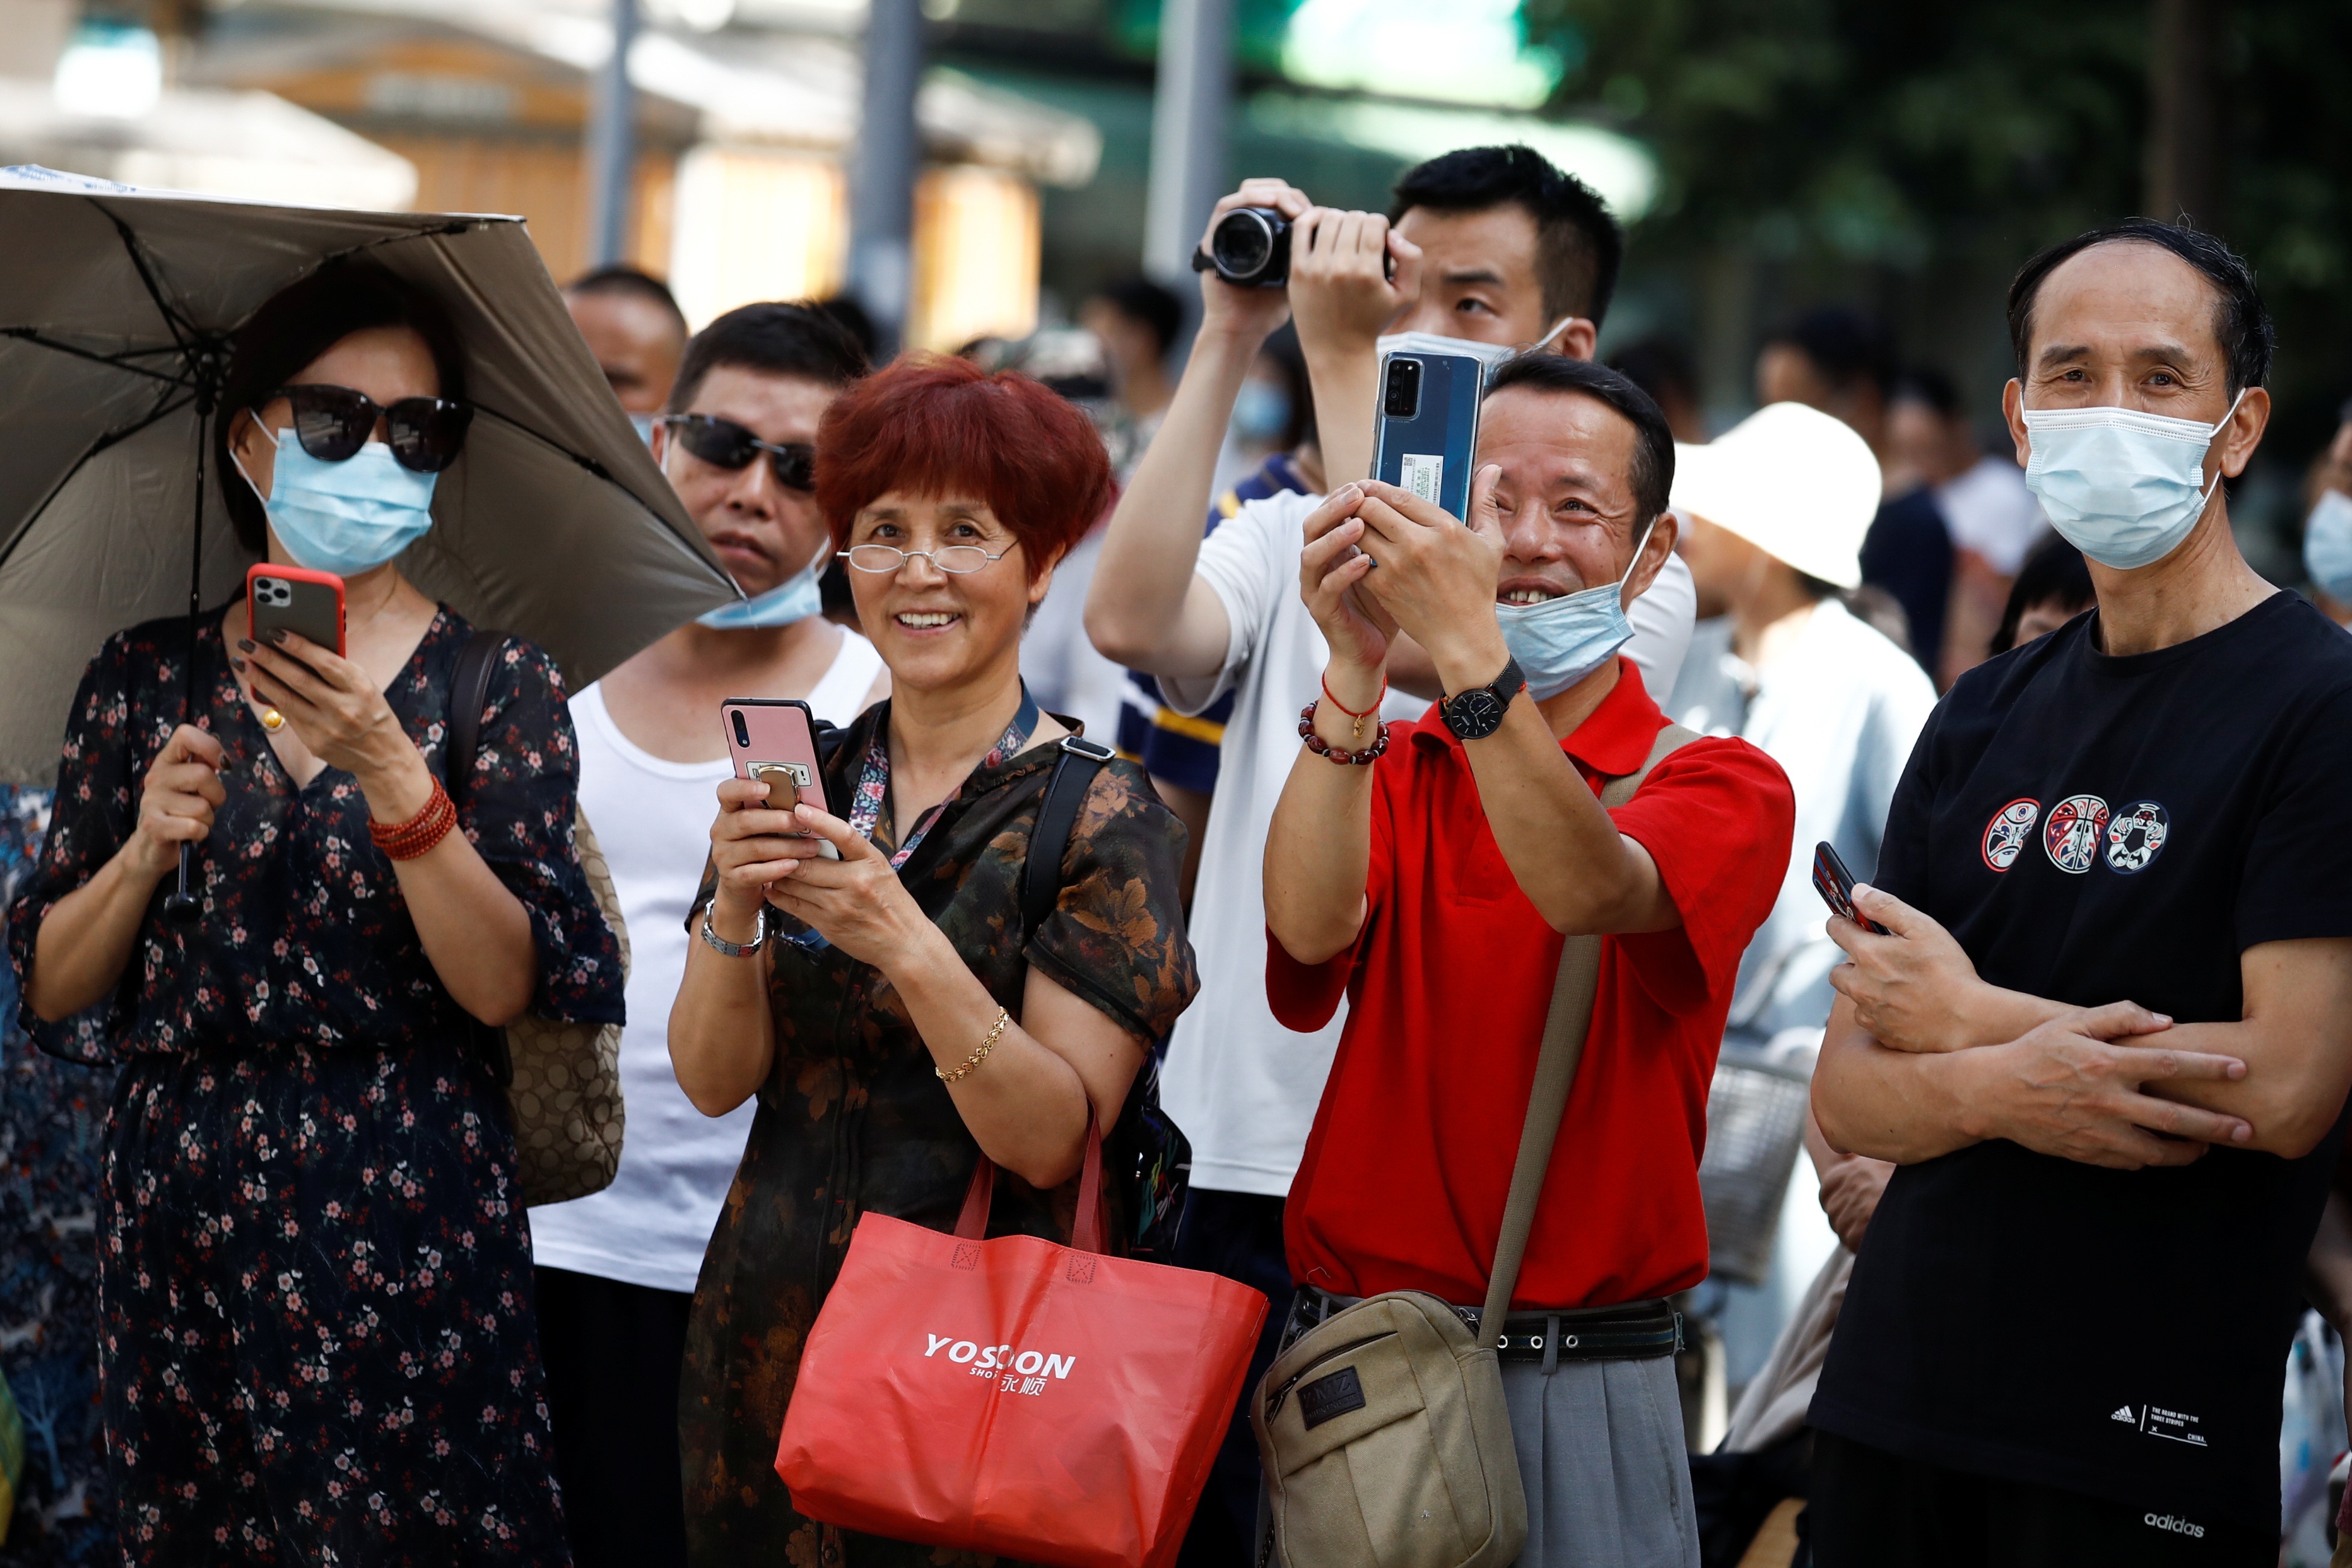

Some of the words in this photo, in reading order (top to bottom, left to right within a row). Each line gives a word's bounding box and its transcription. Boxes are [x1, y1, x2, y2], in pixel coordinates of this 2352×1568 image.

[999, 1373, 1048, 1396] 永顺
[2111, 1413, 2136, 1424] adidas
[2151, 1413, 2165, 1423] THREE
[2165, 1417, 2184, 1427] STRIPES
[2152, 1406, 2161, 1414] THE
[2162, 1409, 2177, 1418] BRAND
[2177, 1413, 2189, 1421] WITH
[2143, 1512, 2205, 1538] adidas
